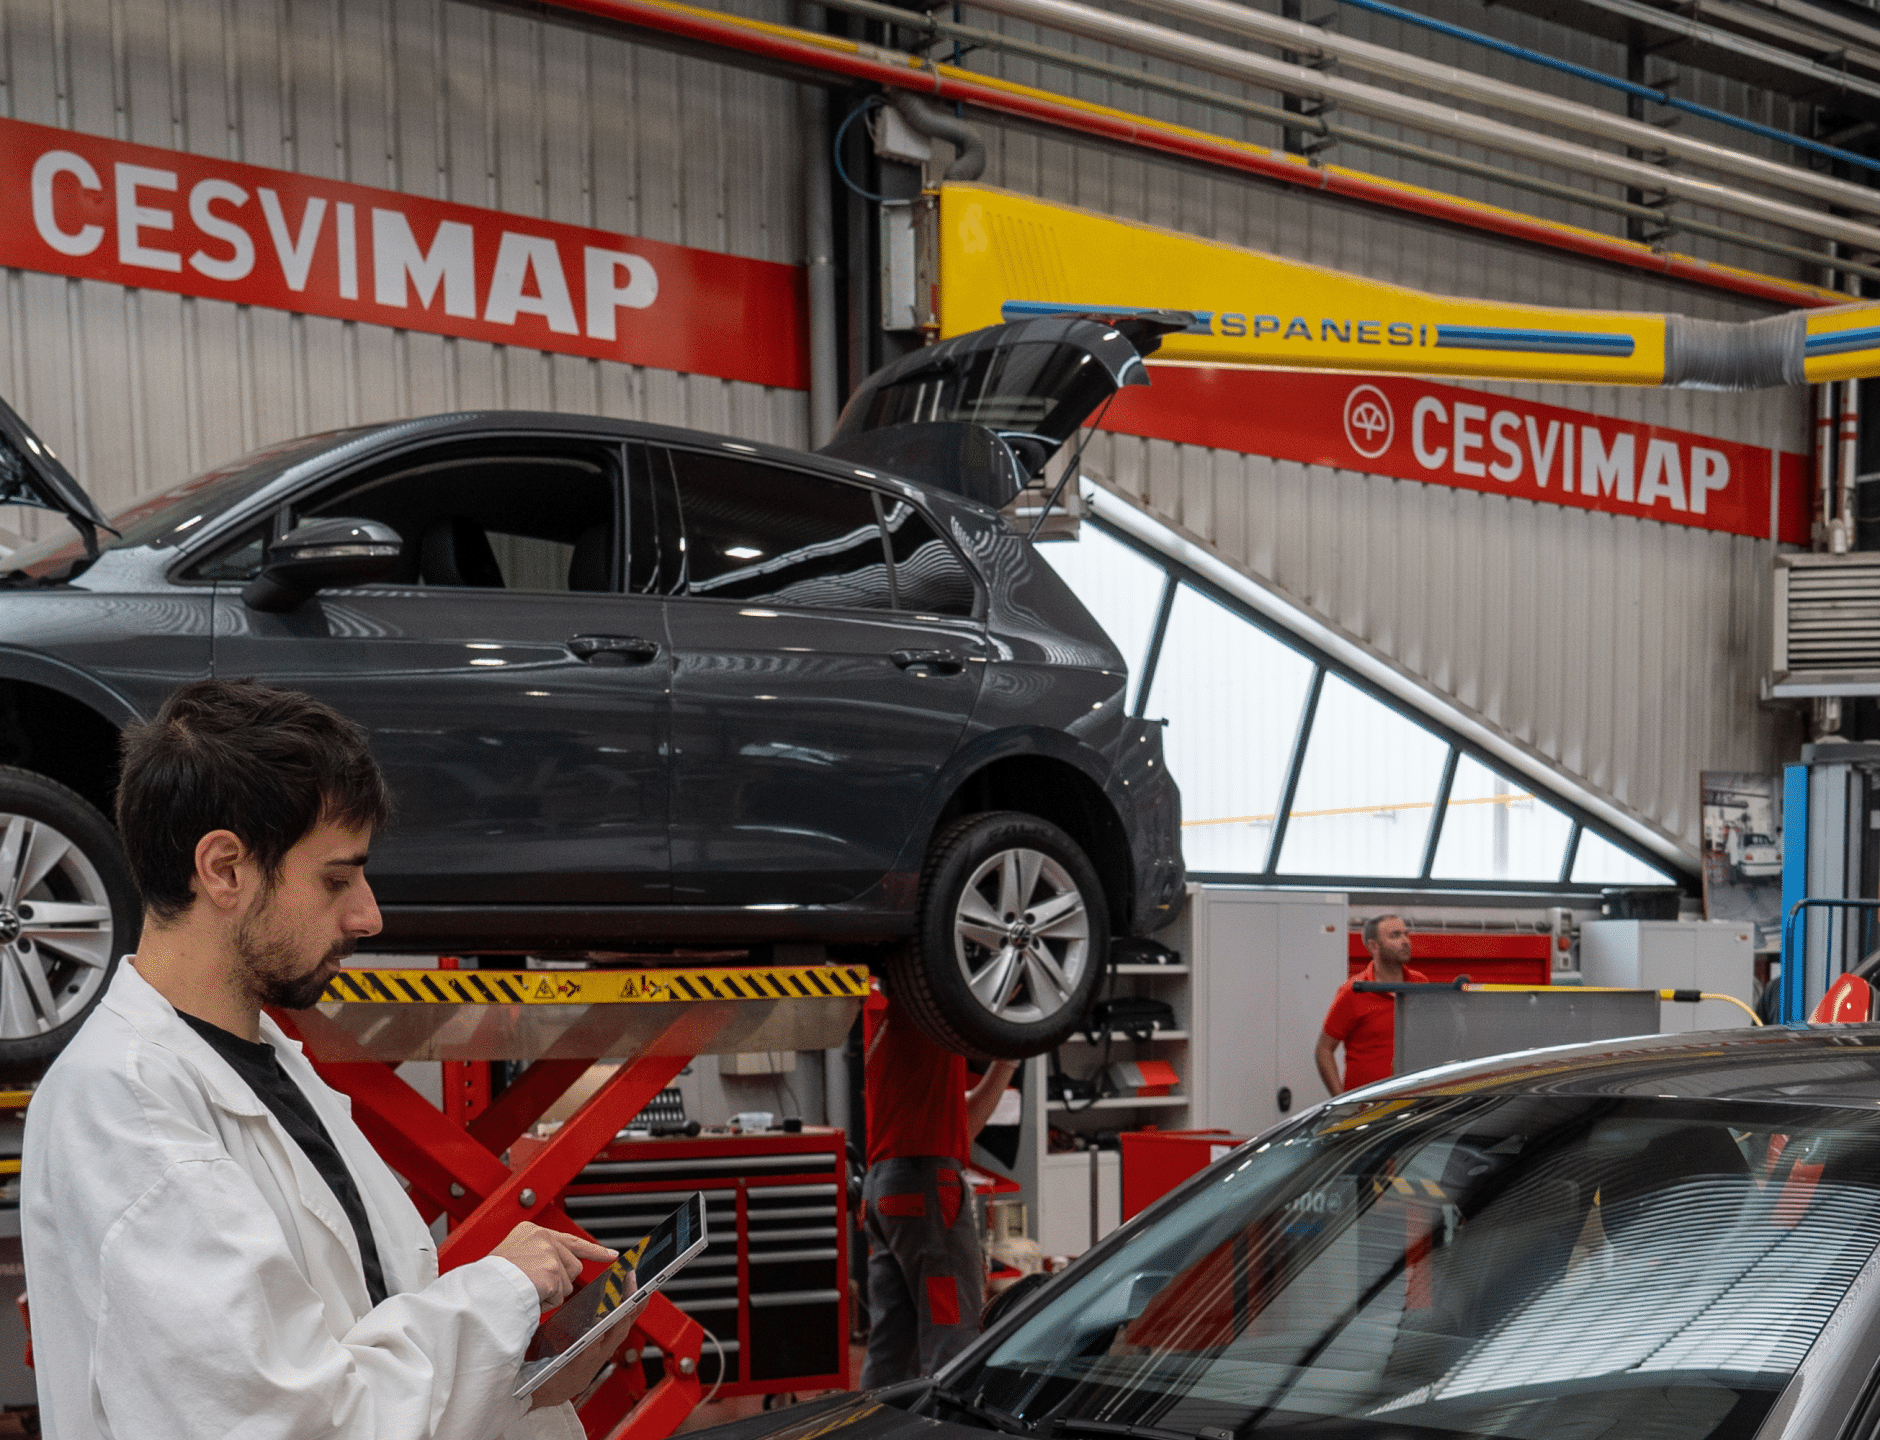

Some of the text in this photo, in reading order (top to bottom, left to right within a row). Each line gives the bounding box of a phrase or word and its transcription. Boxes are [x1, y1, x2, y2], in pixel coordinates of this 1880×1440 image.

[31, 150, 658, 341] CESVIMAP
[1220, 313, 1427, 347] SPANESI
[1411, 395, 1731, 514] CESVIMAP
